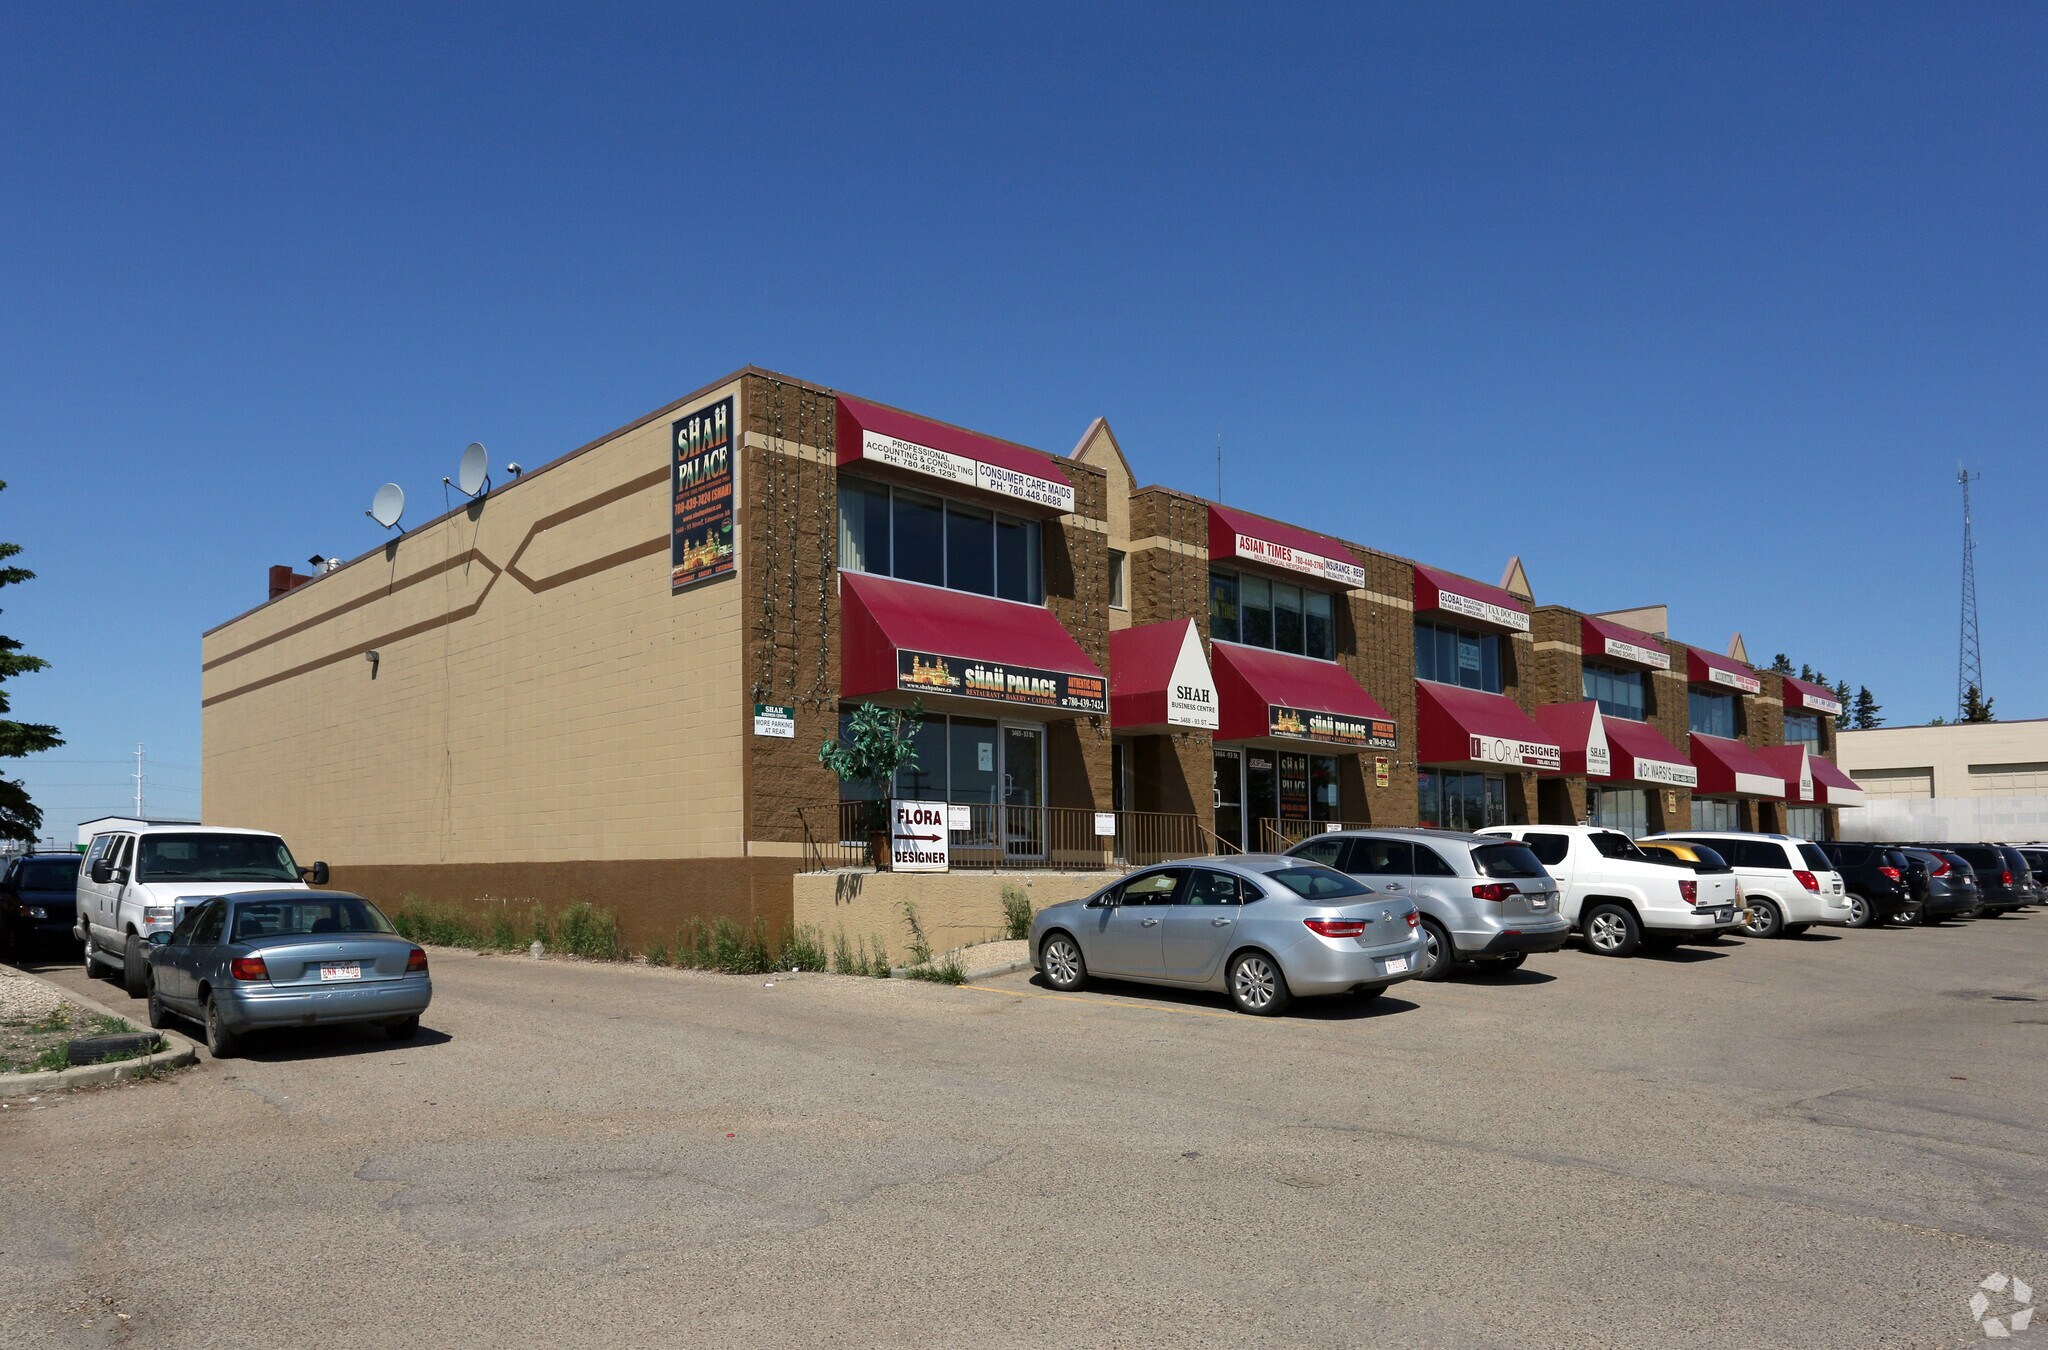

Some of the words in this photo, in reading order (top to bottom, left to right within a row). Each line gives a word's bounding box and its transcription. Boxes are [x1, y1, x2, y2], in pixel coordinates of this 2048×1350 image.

[678, 403, 728, 461] SHAH
[866, 441, 918, 461] ACCOUNTING
[919, 455, 925, 463] &
[927, 457, 974, 476] CONSULTING
[892, 439, 951, 462] PROFESSIONAL
[678, 446, 728, 493] PALACE
[884, 454, 900, 464] PH:
[903, 459, 957, 479] 780.485.1295
[979, 464, 1025, 487] CONSUMER
[1025, 477, 1046, 492] CARE
[1048, 483, 1071, 499] MAIDS
[990, 479, 1006, 492] PH:
[1008, 484, 1062, 507] 780.448.0688
[1239, 536, 1264, 554] ASIAN
[1267, 543, 1292, 561] TIMES
[1285, 562, 1311, 573] NEWSPAPER
[1325, 560, 1350, 575] INSURANCE
[1440, 592, 1462, 606] GLOBAL
[1488, 604, 1500, 616] TAX
[1500, 608, 1529, 624] DOCTORS
[965, 664, 1004, 692] SHAH
[1007, 674, 1057, 698] PALACE
[965, 688, 1001, 699] RESTAURANT
[1005, 694, 1026, 702] BAKERY
[1031, 697, 1057, 706] CATERING
[1176, 685, 1210, 703] SHAH
[765, 705, 784, 714] SHAH
[1068, 697, 1104, 710] 780-439-7424
[1171, 701, 1196, 711] BUSINESS
[1196, 704, 1216, 713] CENTRE
[756, 719, 770, 727] MORE
[771, 720, 793, 729] PARKING
[1309, 714, 1334, 736] SHAH
[1335, 721, 1367, 741] PALACE
[1481, 739, 1521, 763] FLORA
[1519, 743, 1560, 758] DESIGNER
[1590, 746, 1606, 759] SHAH
[1281, 756, 1305, 779] SHAH
[1643, 762, 1651, 777] Dr.
[1282, 779, 1306, 797] PALACE
[897, 808, 942, 826] FLORA
[895, 851, 946, 864] DESIGNER
